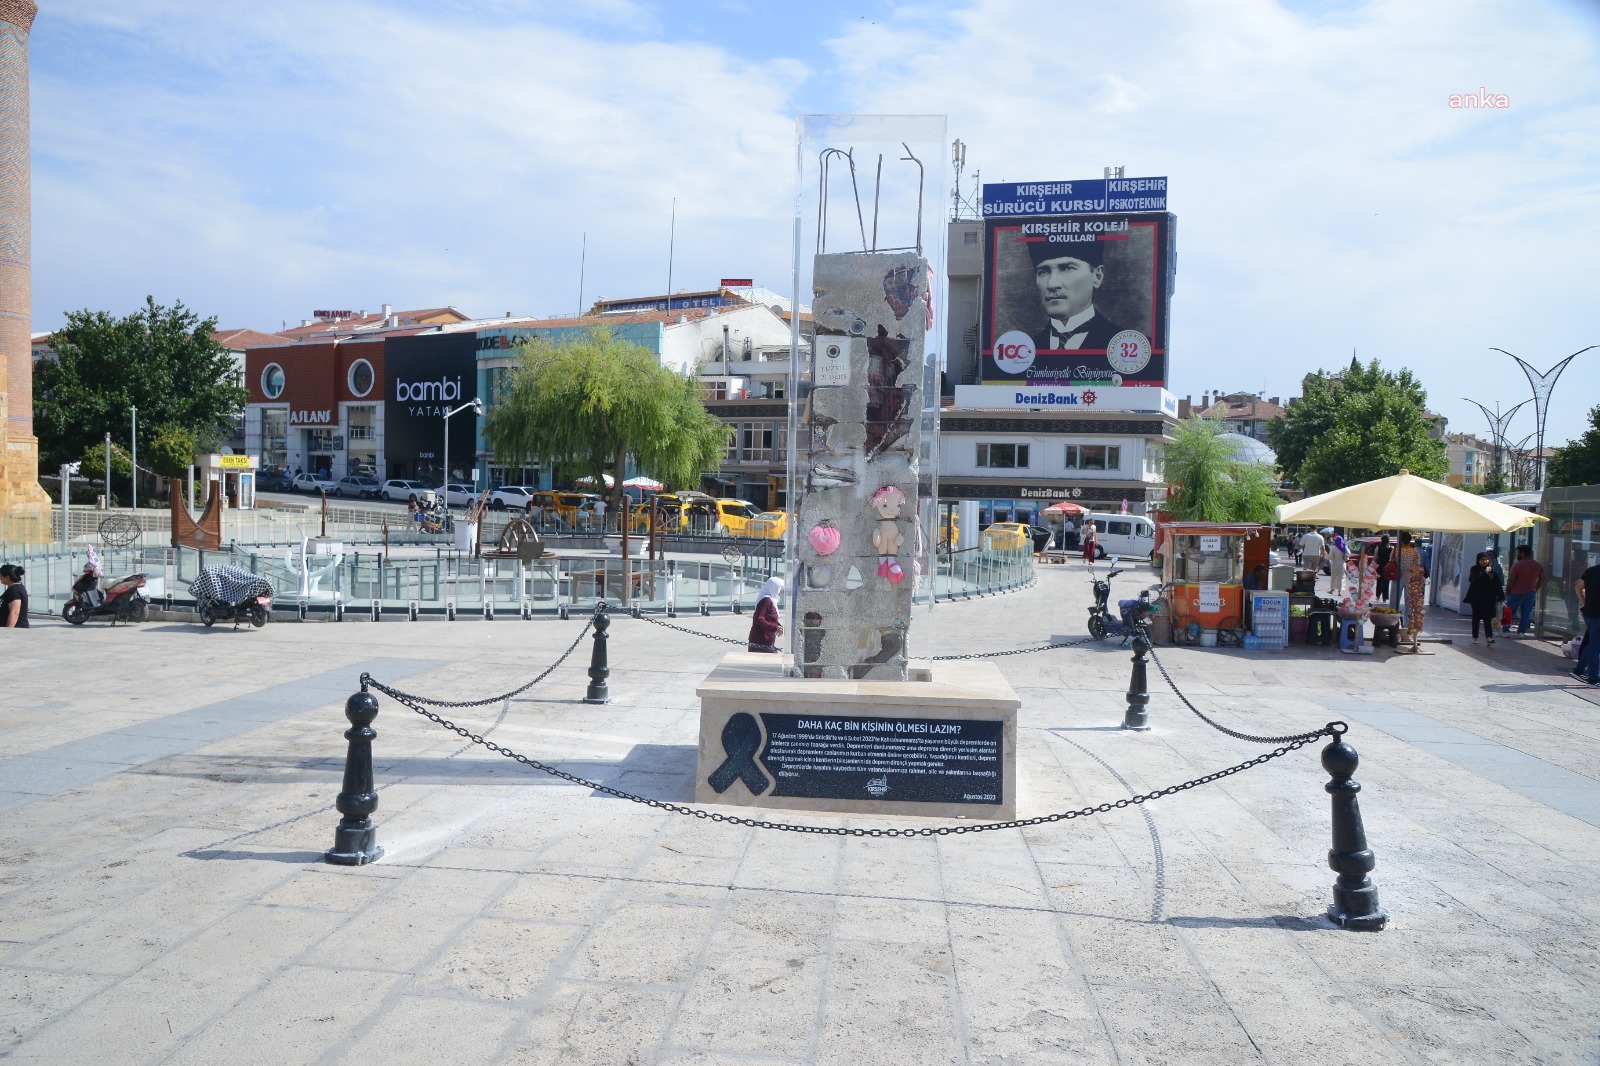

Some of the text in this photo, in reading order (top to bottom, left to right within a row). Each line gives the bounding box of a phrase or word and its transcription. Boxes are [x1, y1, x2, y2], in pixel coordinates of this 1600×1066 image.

[984, 198, 1104, 214] SÜRÜCÜ KURSU
[1022, 218, 1129, 235] KIRŞEHİR KOLEJİ
[1048, 234, 1096, 243] OKULLARI
[682, 299, 716, 309] OTEL
[1120, 342, 1138, 358] 32
[396, 376, 460, 402] bambi
[1016, 392, 1078, 404] DenizBank
[1021, 488, 1070, 498] DenizBank
[798, 720, 961, 734] DAHA KAÇ BİN KİŞİNİN ÖLMESİ LAZIM?
